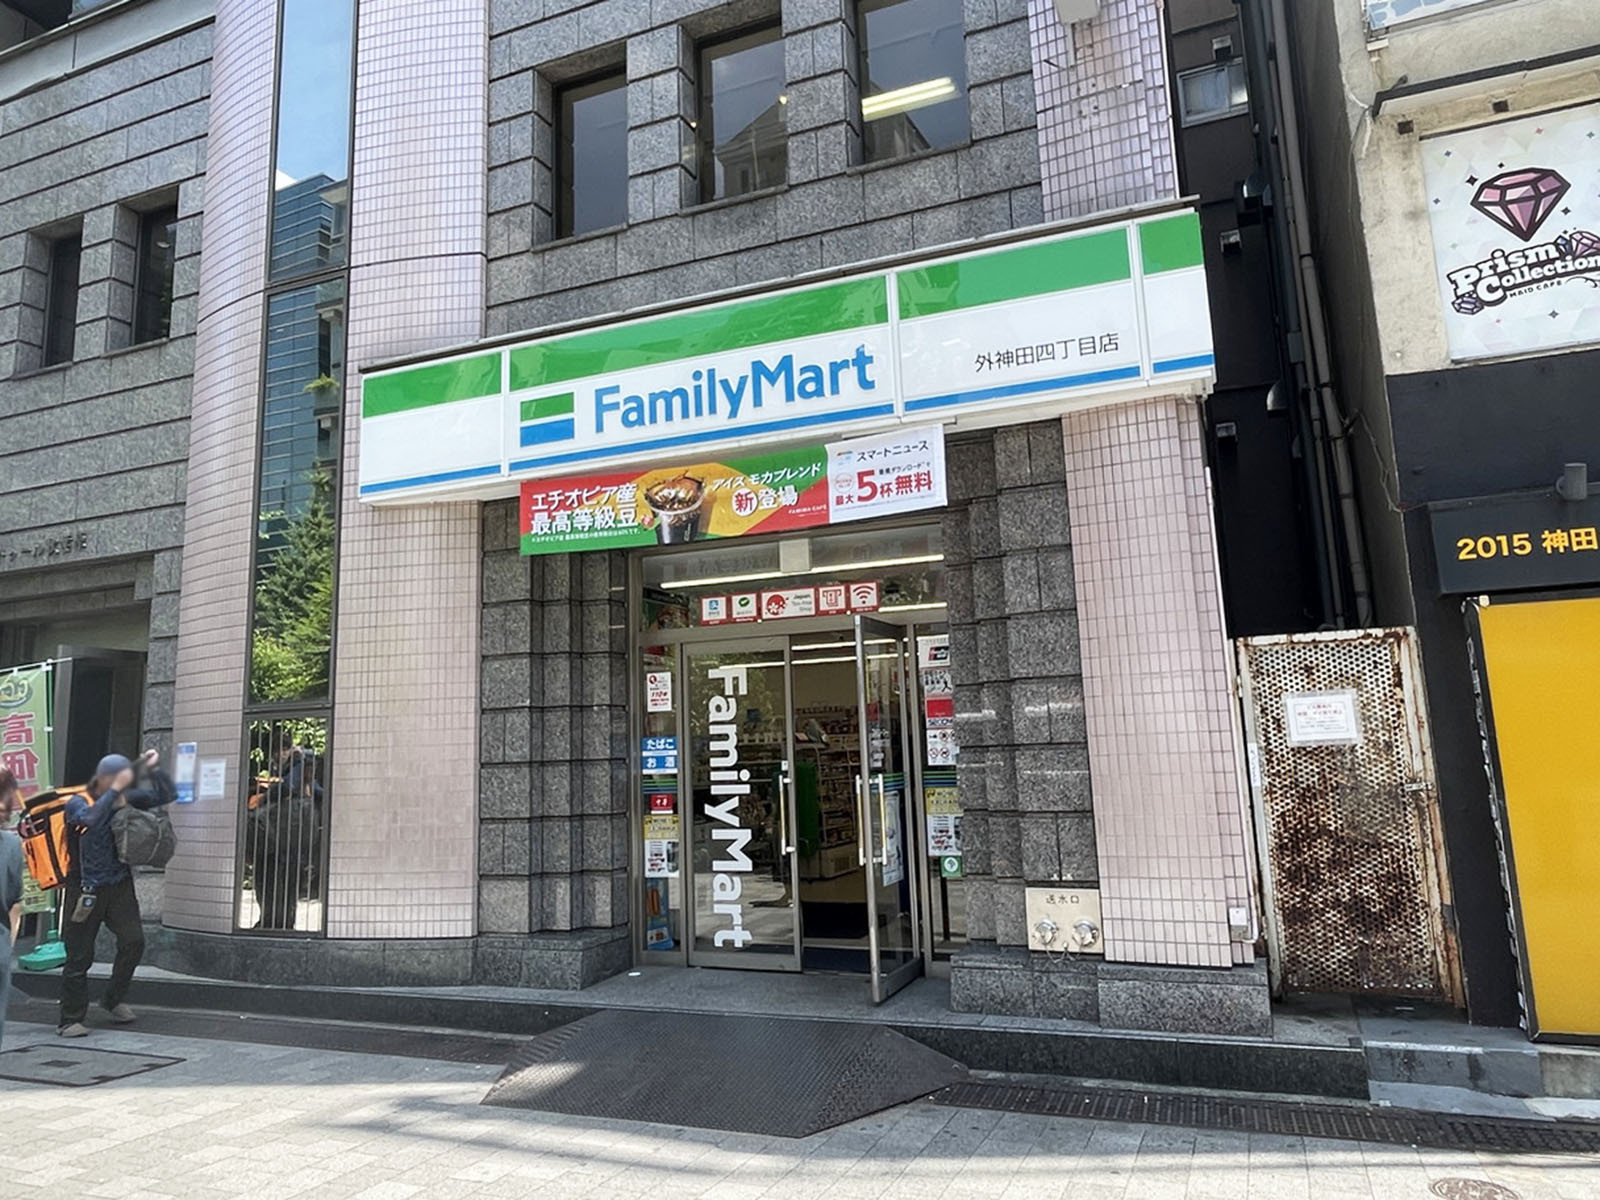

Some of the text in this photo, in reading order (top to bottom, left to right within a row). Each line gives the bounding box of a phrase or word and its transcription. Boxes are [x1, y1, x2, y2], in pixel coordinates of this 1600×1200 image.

[1448, 243, 1560, 296] Prism
[1509, 286, 1534, 298] MAID
[974, 332, 1120, 373] 外神田四丁目店
[594, 344, 876, 434] FamilyMart
[857, 440, 929, 462] スマートニュース
[712, 476, 746, 491] アイス
[748, 462, 822, 485] モカブレンド
[531, 482, 638, 512] エチオピア産
[530, 502, 639, 535] 最高等級豆
[1456, 526, 1599, 561] 2015 神田
[646, 739, 675, 751] たばこ
[704, 666, 753, 948] FamilyMart
[1046, 894, 1080, 905] 送水口
